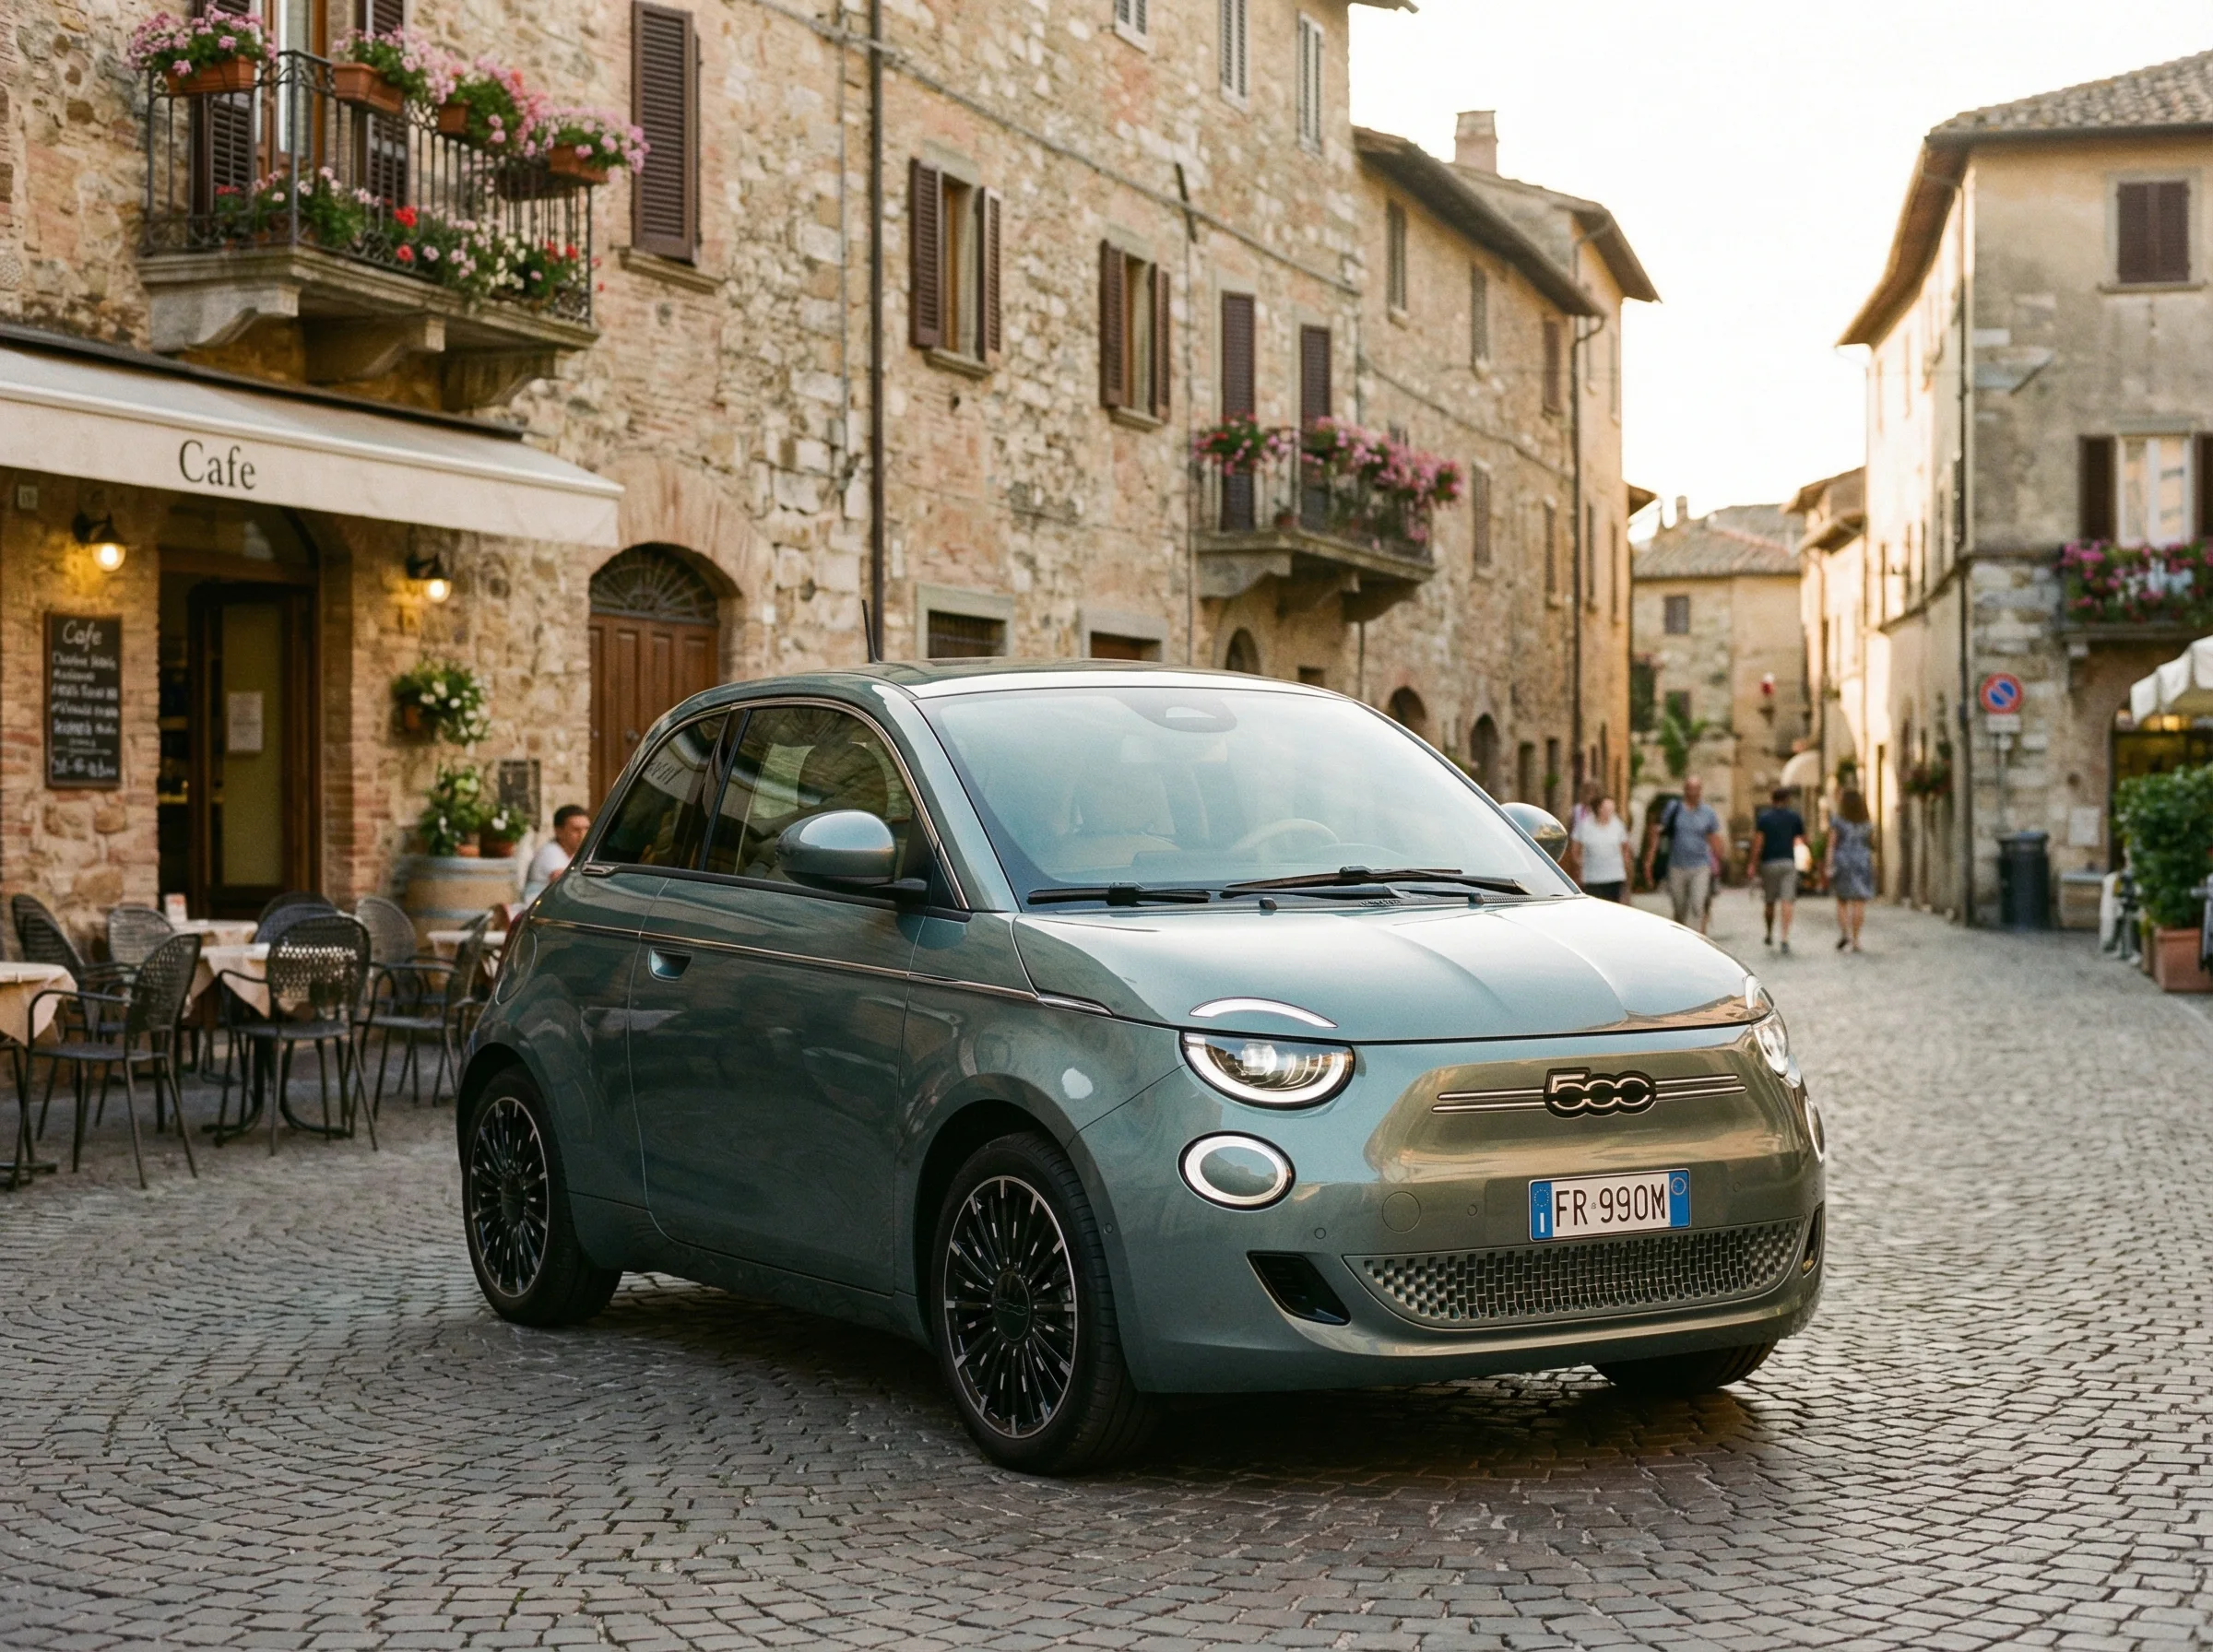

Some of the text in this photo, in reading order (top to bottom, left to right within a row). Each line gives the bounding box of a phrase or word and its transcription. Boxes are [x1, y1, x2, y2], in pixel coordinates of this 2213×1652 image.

[179, 439, 256, 490] Cafe
[62, 620, 103, 652] Cafe
[1547, 1071, 1652, 1113] 500
[1555, 1189, 1588, 1228] FR
